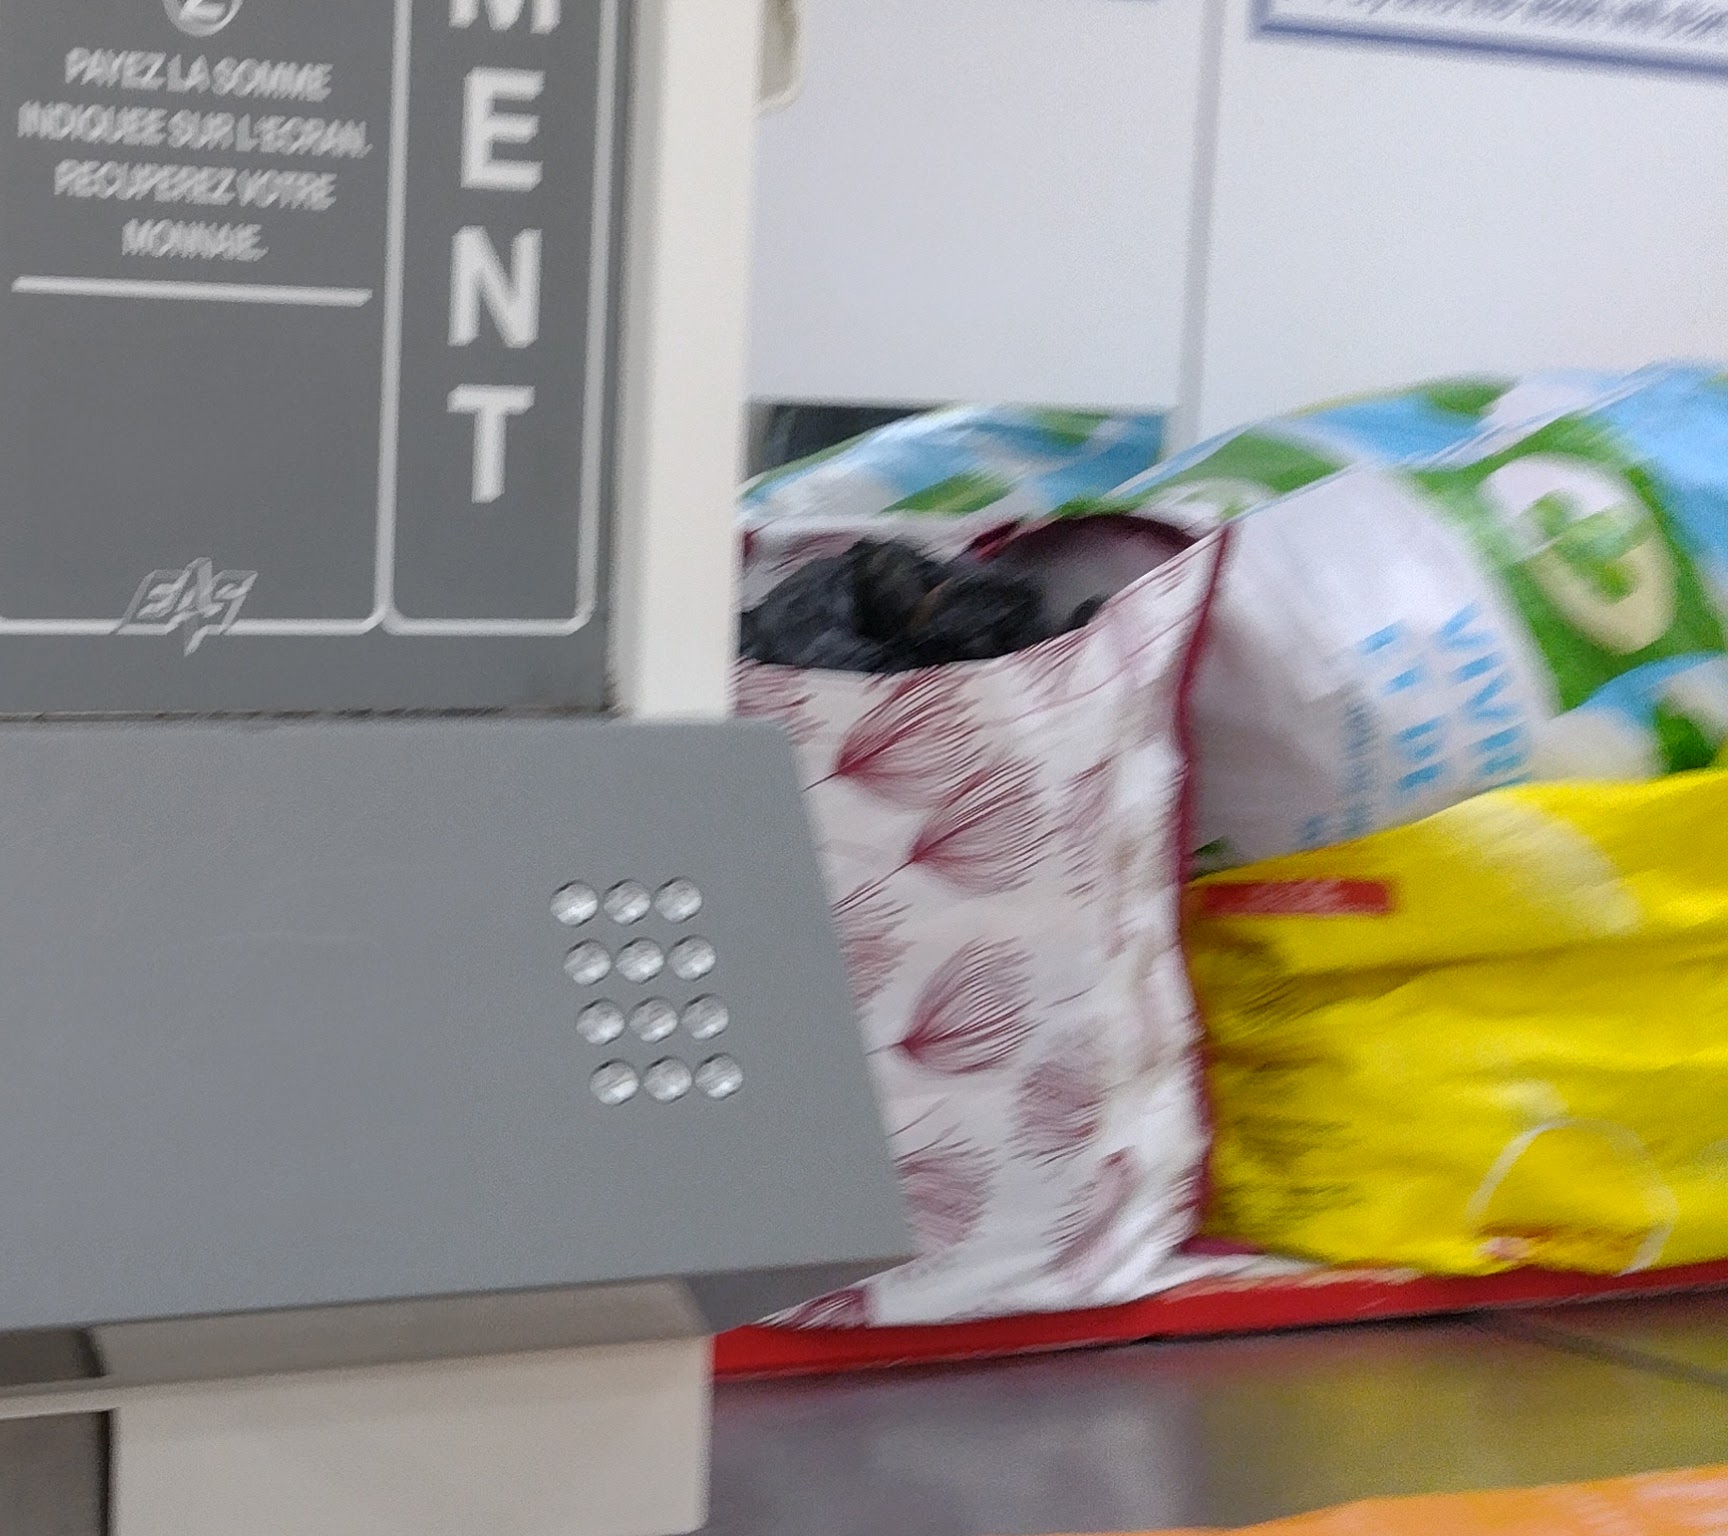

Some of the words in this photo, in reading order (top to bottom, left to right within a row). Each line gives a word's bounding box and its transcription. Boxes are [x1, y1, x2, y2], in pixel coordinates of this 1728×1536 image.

[64, 46, 167, 91] PAYEZ
[167, 53, 211, 94] LA
[212, 56, 334, 103] SOMME
[17, 99, 169, 146] INDIQUEE
[168, 108, 236, 151] SUR
[53, 158, 237, 206] RECUPEREZ
[236, 167, 338, 212] VOTRE
